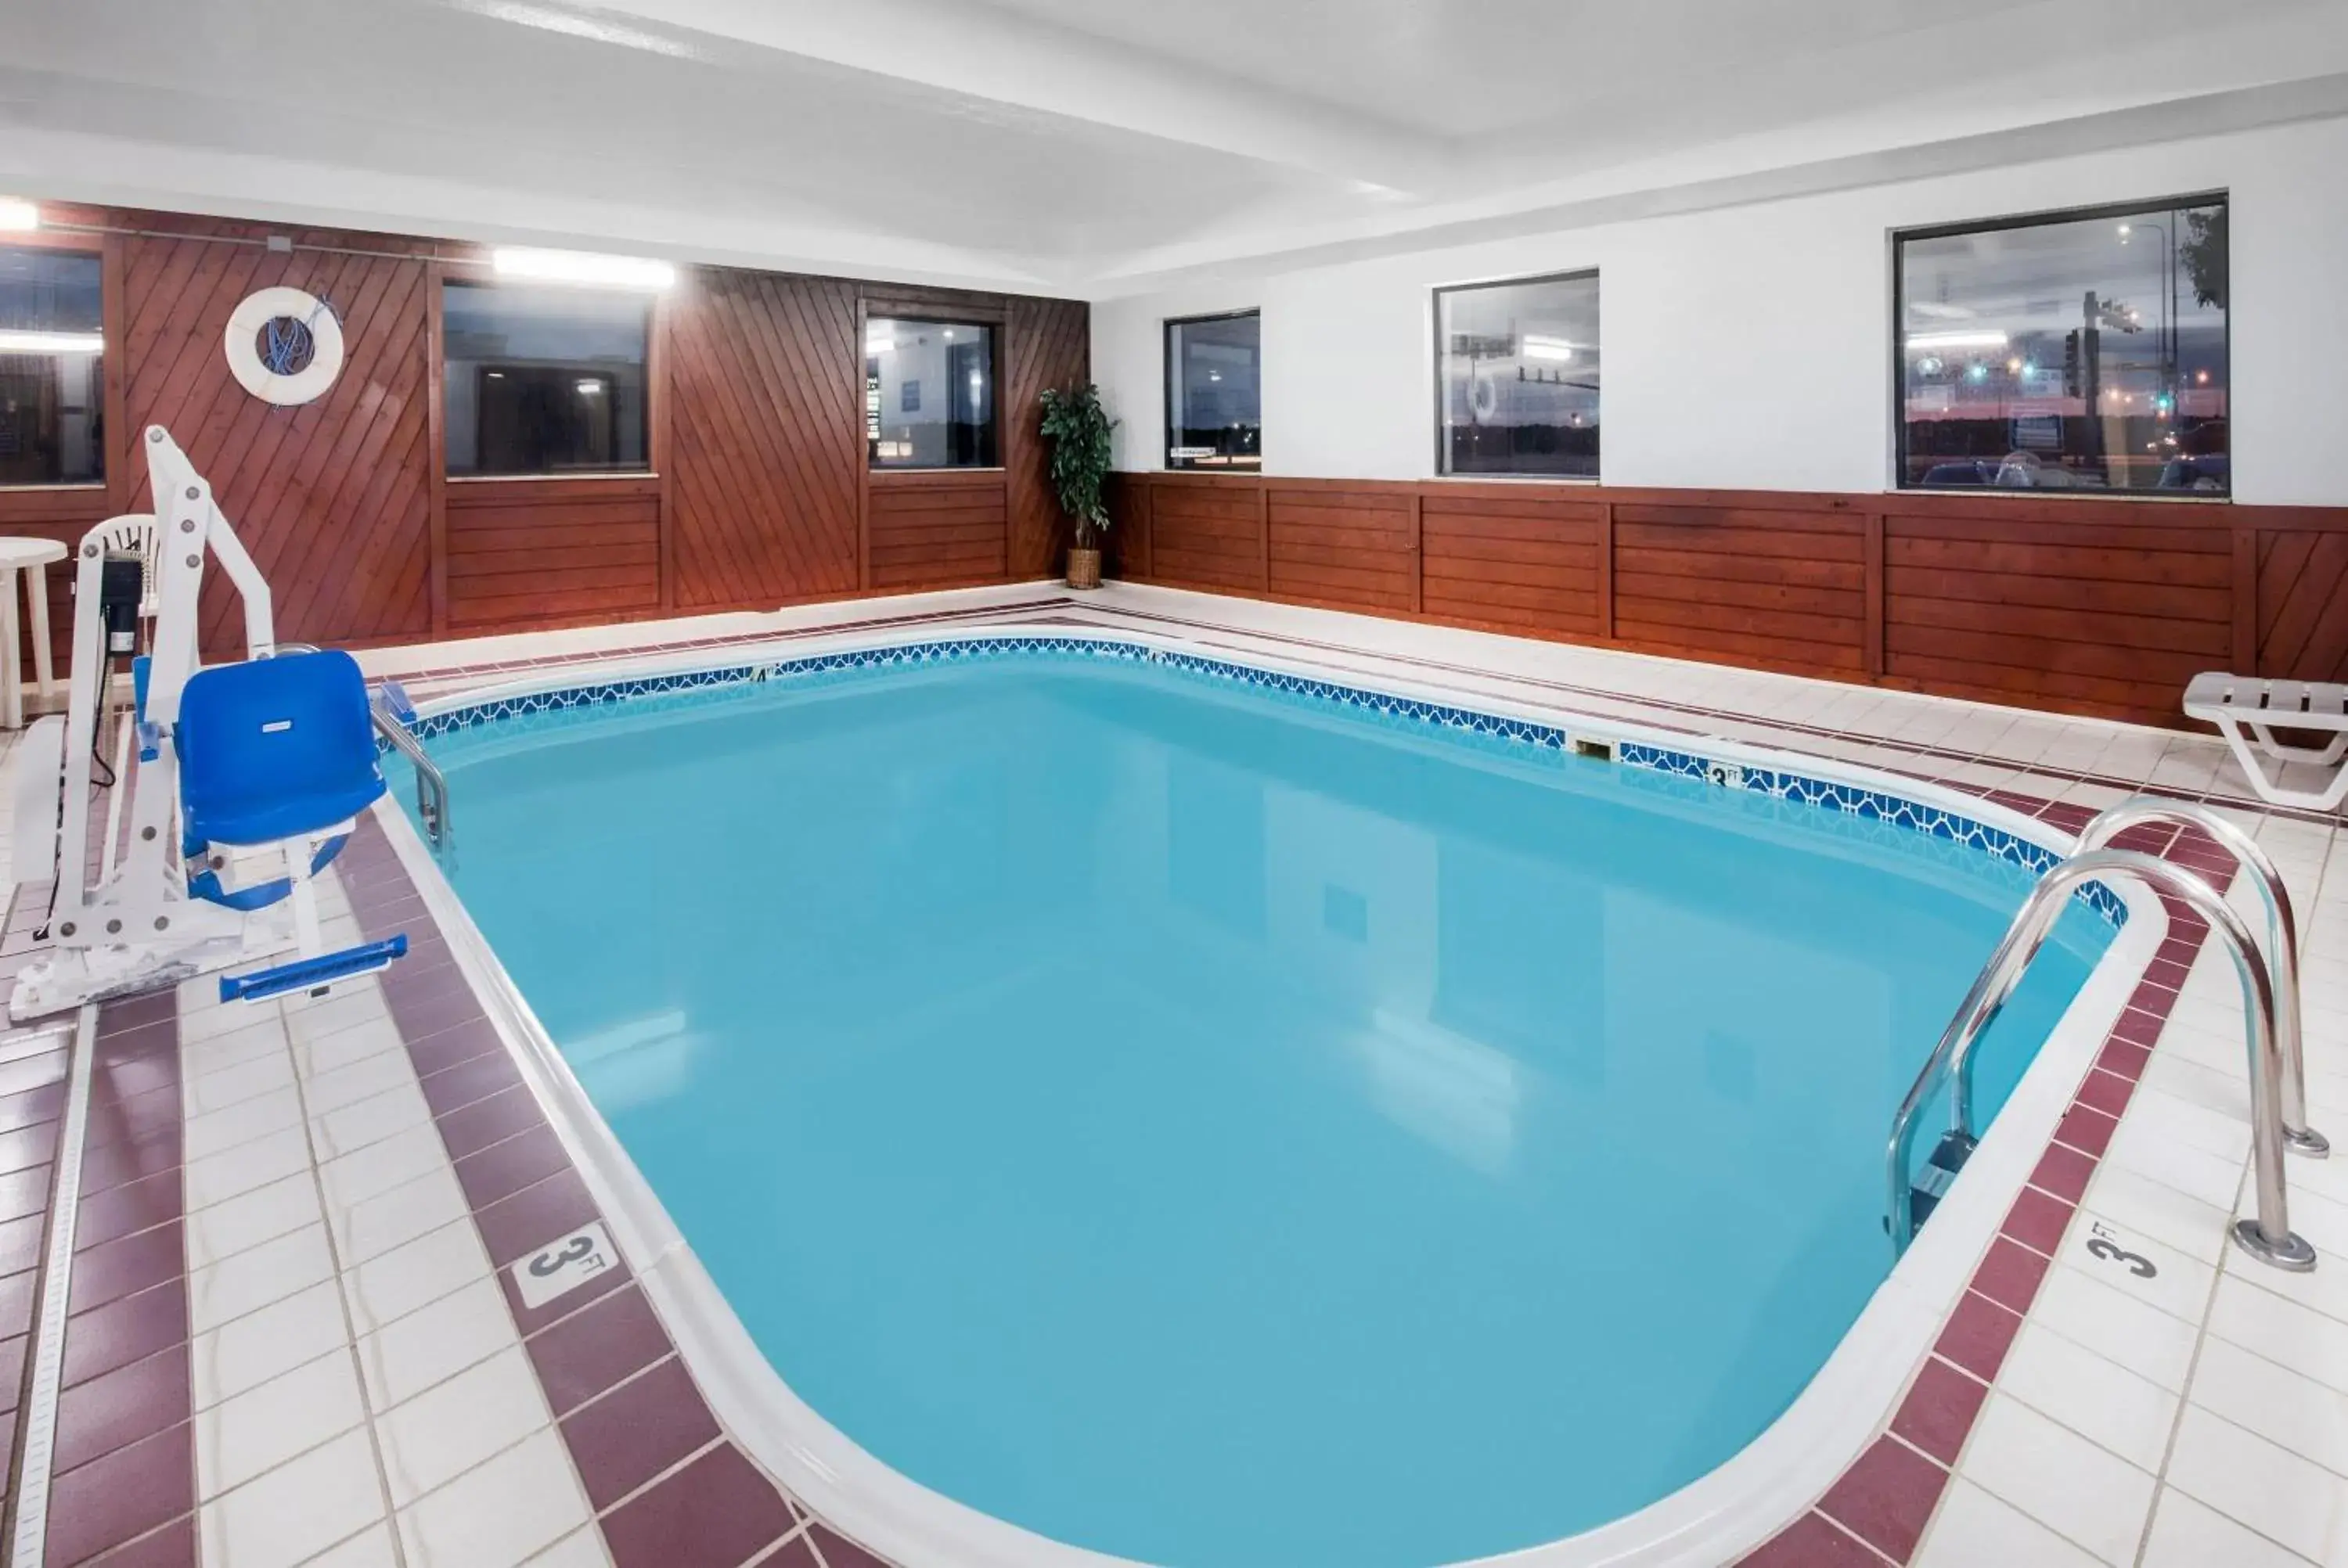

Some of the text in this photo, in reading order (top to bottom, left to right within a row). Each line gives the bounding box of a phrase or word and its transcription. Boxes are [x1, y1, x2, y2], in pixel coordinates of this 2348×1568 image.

[1727, 769, 1738, 780] FT
[528, 1235, 606, 1277] 3 FT
[2087, 1221, 2158, 1278] 3 FT
